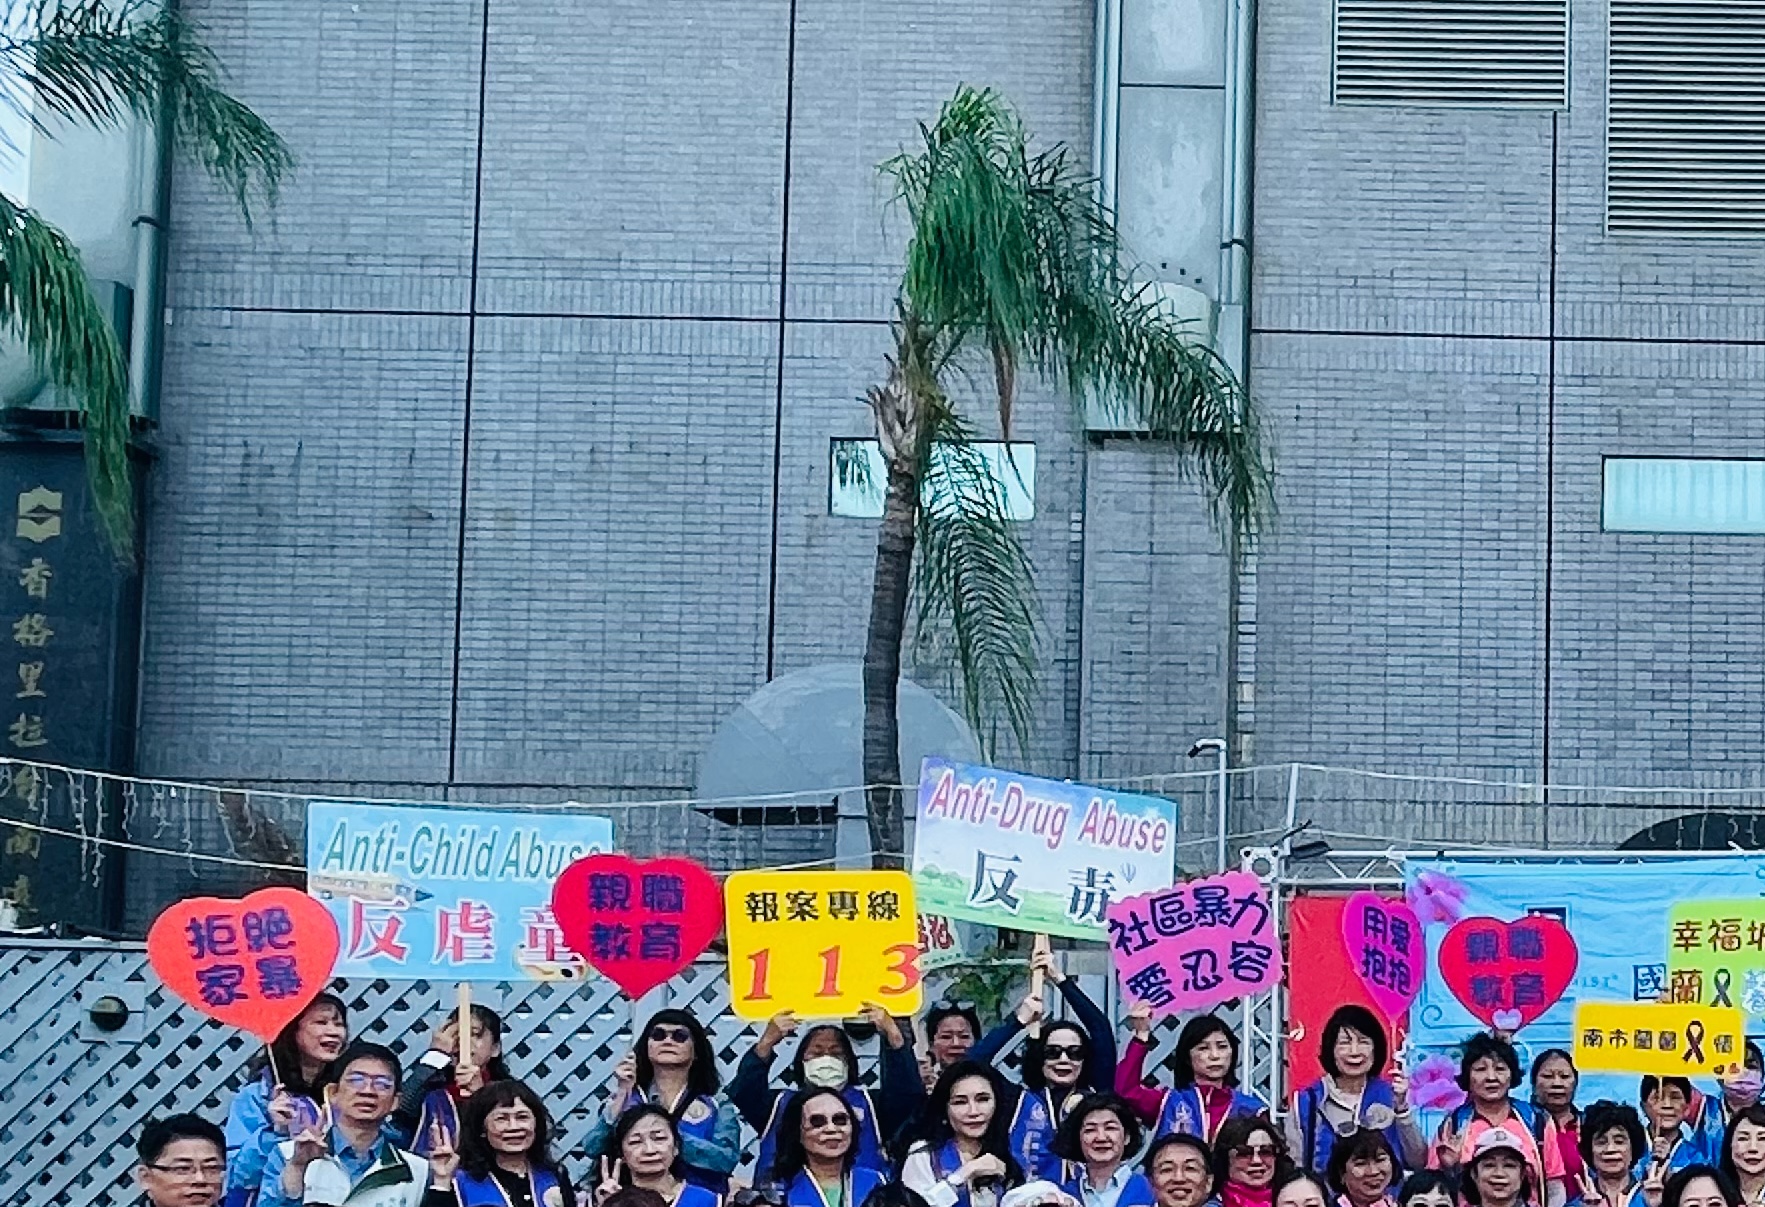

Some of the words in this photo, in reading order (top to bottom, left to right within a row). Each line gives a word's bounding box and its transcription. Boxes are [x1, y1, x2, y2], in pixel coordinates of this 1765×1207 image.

[927, 773, 1071, 851] Anti-Drug
[1077, 800, 1168, 853] Abuse
[320, 819, 499, 878] Anti-Child
[588, 873, 684, 911] 親職
[744, 890, 900, 922] 報案專線
[184, 906, 296, 960] 拒絕
[588, 922, 681, 961] 教育
[1107, 885, 1269, 957] 社區暴力
[1363, 905, 1411, 958] 用愛
[195, 955, 303, 1008] 家暴
[743, 944, 924, 1001] 113
[1361, 945, 1412, 998] 抱抱
